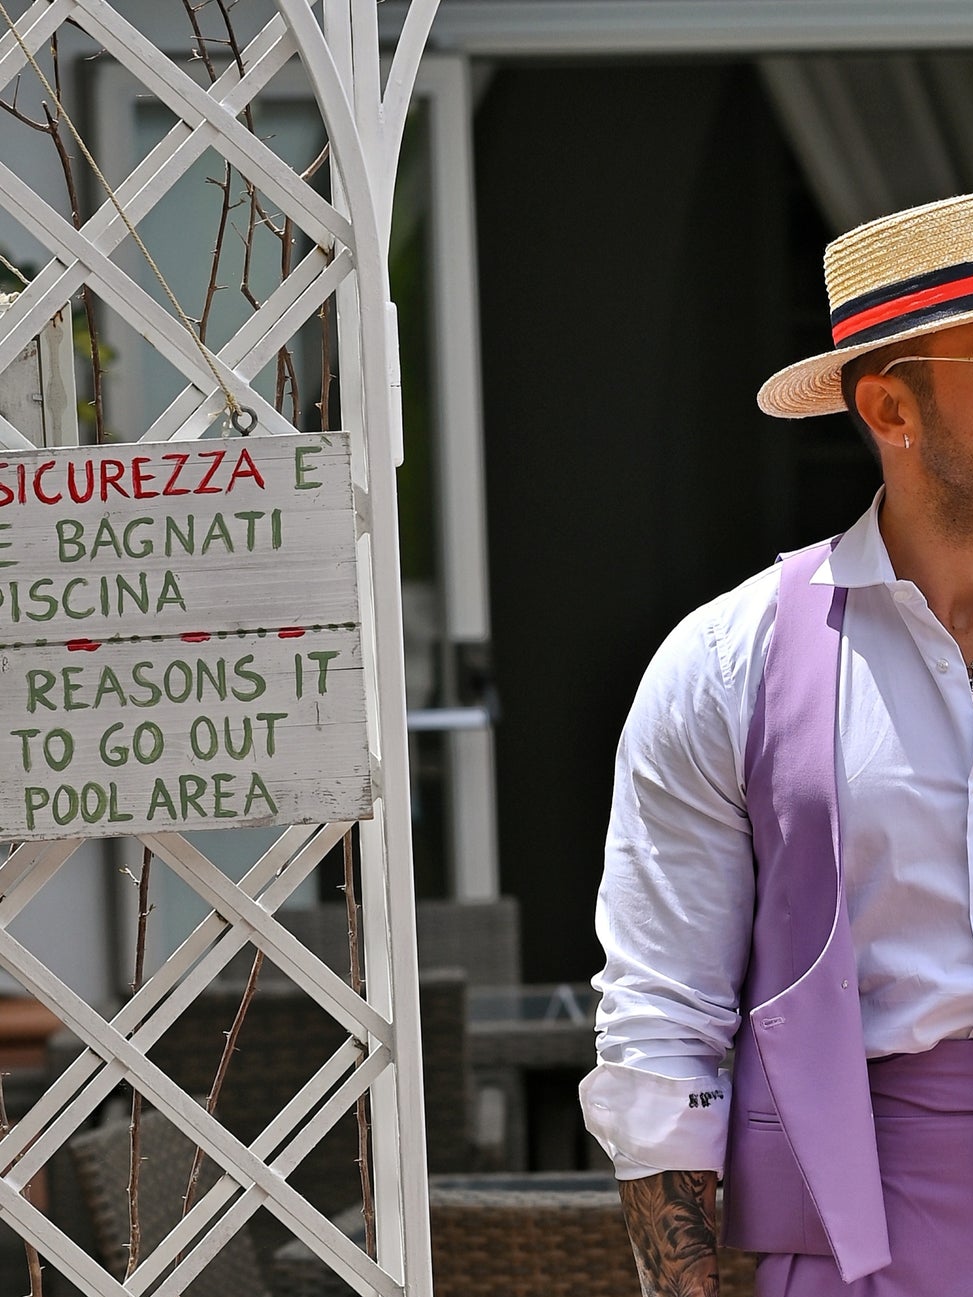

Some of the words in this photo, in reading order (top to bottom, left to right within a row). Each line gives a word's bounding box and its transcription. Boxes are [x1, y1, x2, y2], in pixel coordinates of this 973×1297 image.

[56, 508, 282, 562] BAGNATI
[0, 570, 187, 622] ISCINA
[25, 653, 267, 714] REASONS
[294, 650, 342, 700] IT
[10, 728, 75, 772] TO
[100, 721, 164, 767] GO
[190, 712, 288, 761] OUT
[24, 781, 133, 830] POOL
[146, 771, 279, 820] AREA
